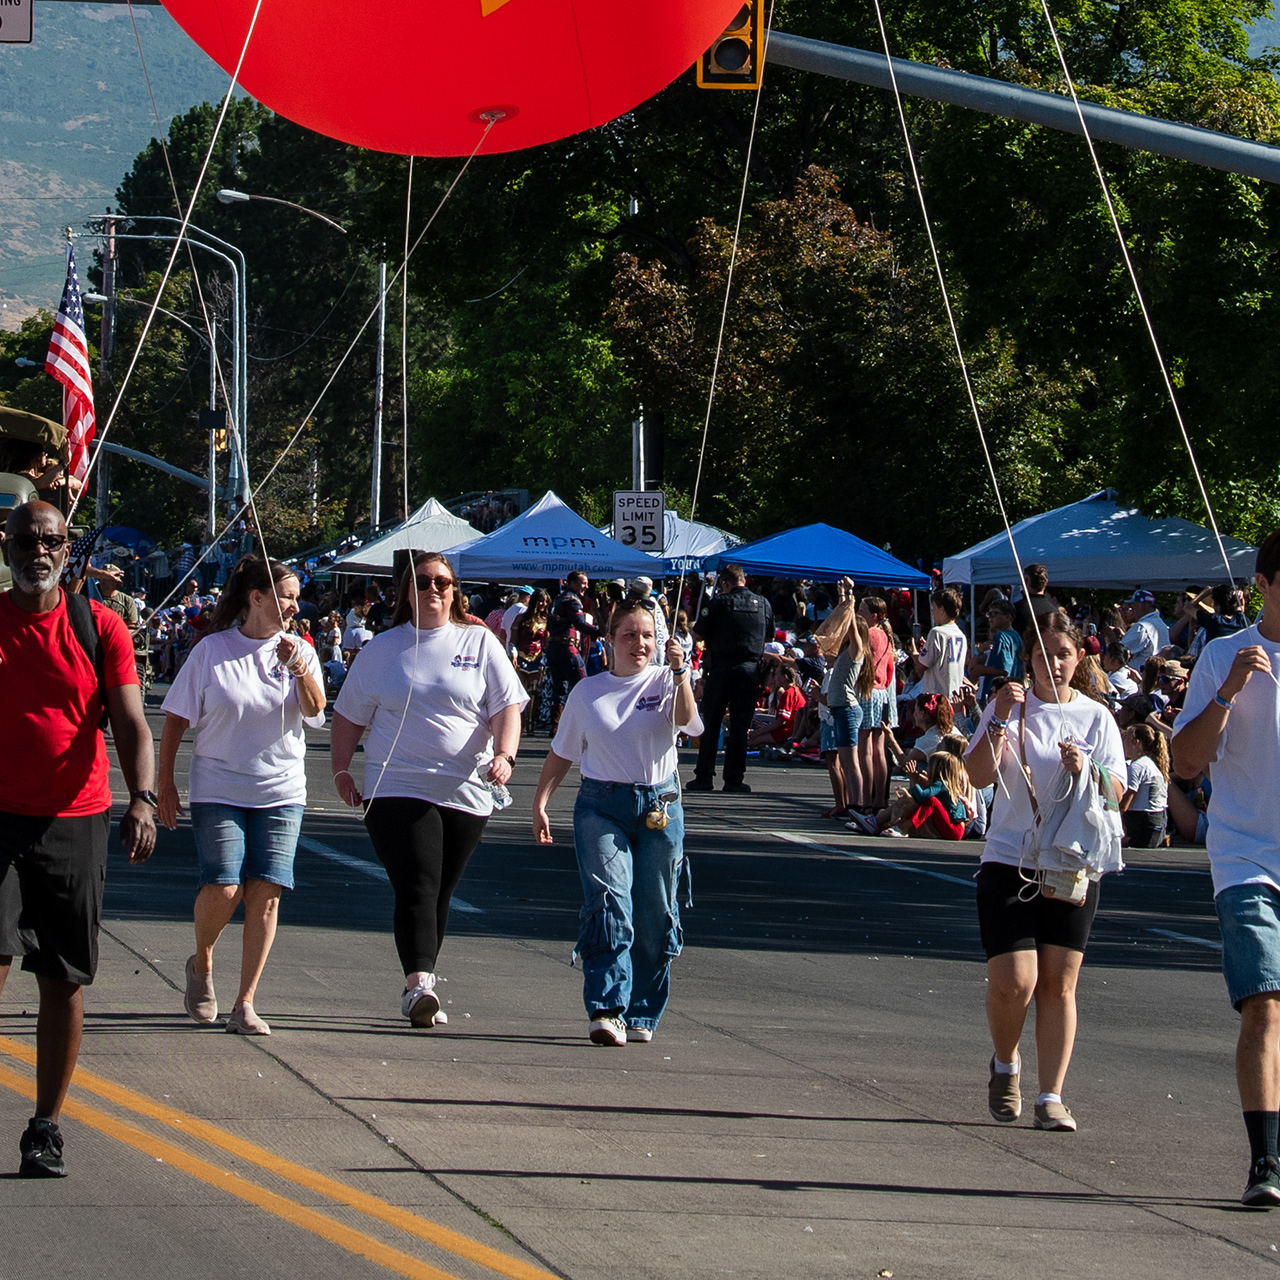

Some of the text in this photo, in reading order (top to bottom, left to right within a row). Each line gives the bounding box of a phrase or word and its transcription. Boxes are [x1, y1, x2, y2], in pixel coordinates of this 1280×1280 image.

[617, 497, 661, 509] SPEED
[622, 511, 656, 522] LIMIT
[621, 525, 657, 546] 35
[522, 536, 597, 550] mpm
[947, 636, 964, 663] 17
